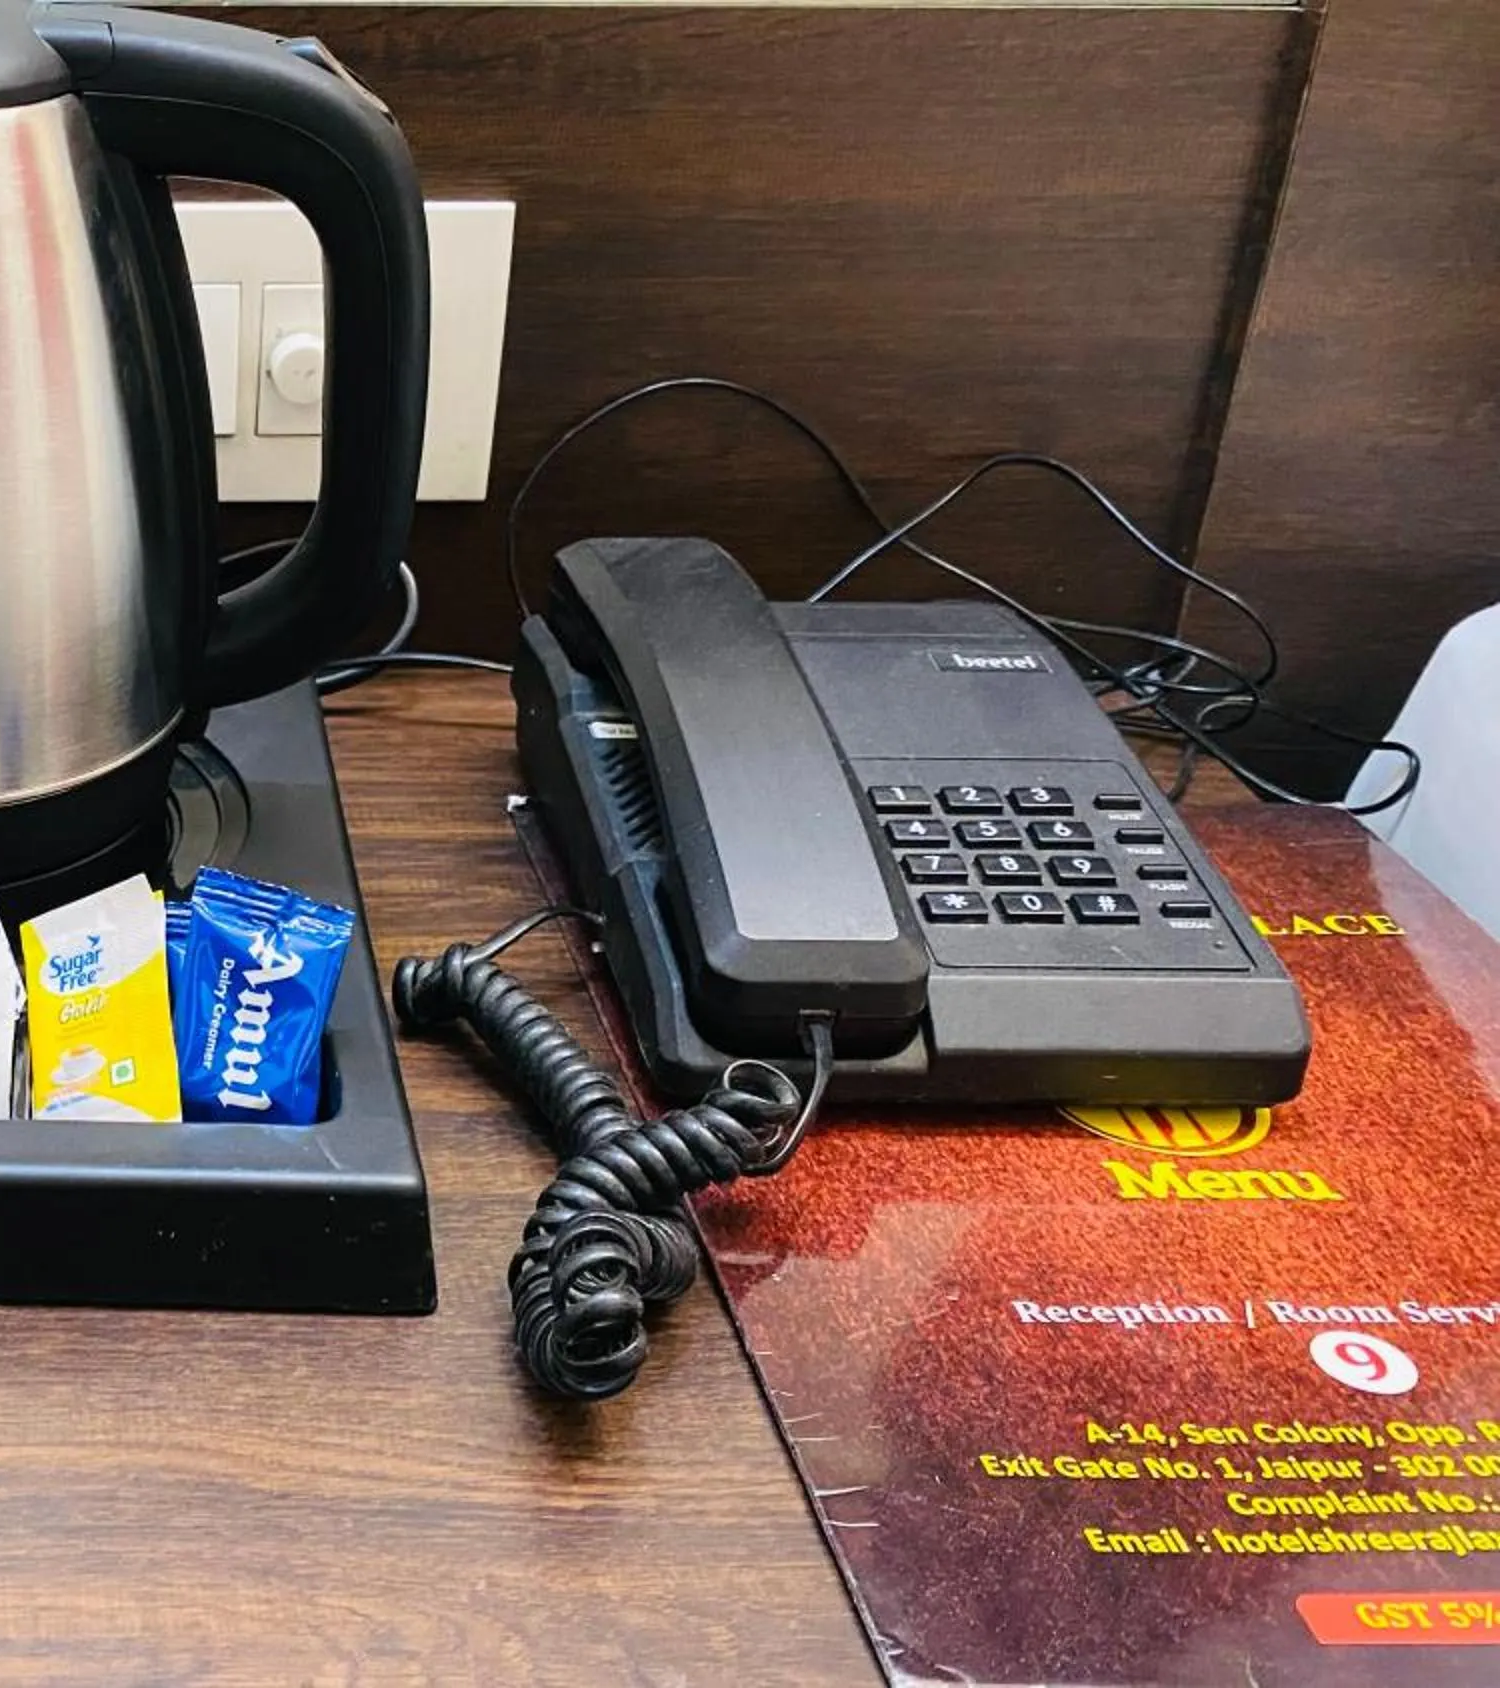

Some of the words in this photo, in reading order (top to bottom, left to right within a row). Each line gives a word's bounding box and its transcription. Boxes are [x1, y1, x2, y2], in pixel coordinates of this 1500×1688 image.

[952, 653, 1037, 669] beetel
[891, 787, 906, 801] 1
[960, 787, 981, 801] 2
[1030, 787, 1050, 803] 3
[908, 821, 926, 835] 4
[979, 821, 998, 837] 5
[1053, 822, 1073, 837] 6
[923, 855, 941, 870] 7
[999, 855, 1019, 871] 8
[1072, 858, 1091, 874] 9
[1022, 894, 1042, 910] 0
[1097, 895, 1117, 912] #
[1250, 914, 1406, 935] LACE
[48, 948, 103, 979] Sugar
[59, 968, 98, 992] Free
[213, 957, 236, 1001] Dairy
[217, 930, 305, 1112] Amul
[202, 1003, 228, 1071] Creamer
[1101, 1160, 1345, 1201] Menu
[1012, 1300, 1229, 1329] Reception
[1268, 1301, 1399, 1325] Room
[1334, 1342, 1389, 1382] 9
[1086, 1421, 1179, 1448] A-14,
[1180, 1422, 1250, 1444] Sen
[1253, 1421, 1385, 1448] Colony,
[1386, 1421, 1478, 1447] Opp.
[979, 1454, 1052, 1477] Exit
[1053, 1455, 1140, 1479] Gate
[1142, 1456, 1212, 1479] No.
[1213, 1456, 1254, 1483] 1,
[1257, 1456, 1363, 1483] Jaipur
[1390, 1455, 1467, 1478] 302
[1227, 1490, 1419, 1519] Complaint
[1083, 1527, 1190, 1553] Email
[1212, 1524, 1500, 1557] hotelshreerajla
[1355, 1602, 1433, 1629] GST
